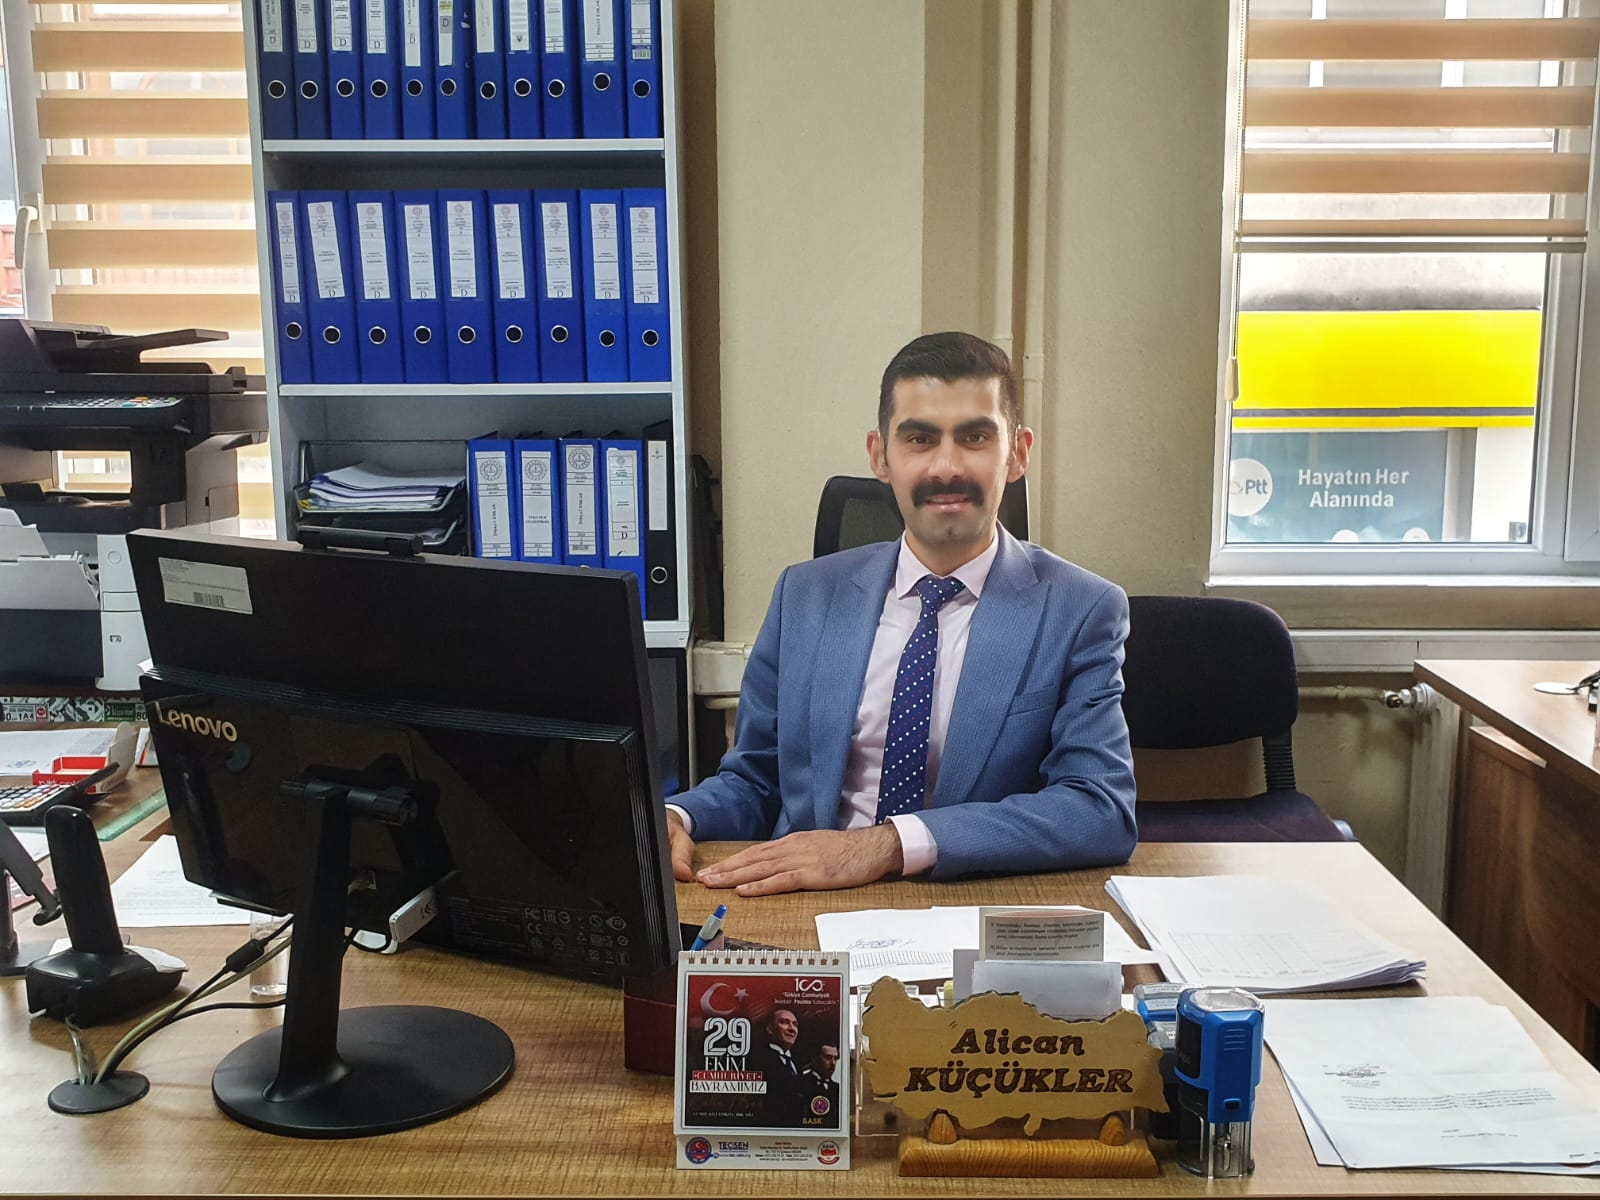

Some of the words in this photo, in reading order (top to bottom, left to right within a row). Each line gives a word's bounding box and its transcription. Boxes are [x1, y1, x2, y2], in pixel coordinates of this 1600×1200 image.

[303, 40, 311, 48] D
[339, 38, 347, 47] D
[373, 40, 381, 49] D
[1245, 479, 1268, 495] Ptt
[1298, 469, 1371, 489] Hayatın
[1375, 468, 1409, 485] Her
[1310, 490, 1394, 508] Alanında
[622, 532, 628, 540] D
[155, 701, 238, 742] Lenovo
[703, 1017, 751, 1056] 29
[950, 1028, 1085, 1056] Alican
[903, 1060, 1134, 1098] KÜÇÜKLER
[802, 1117, 822, 1125] BASK
